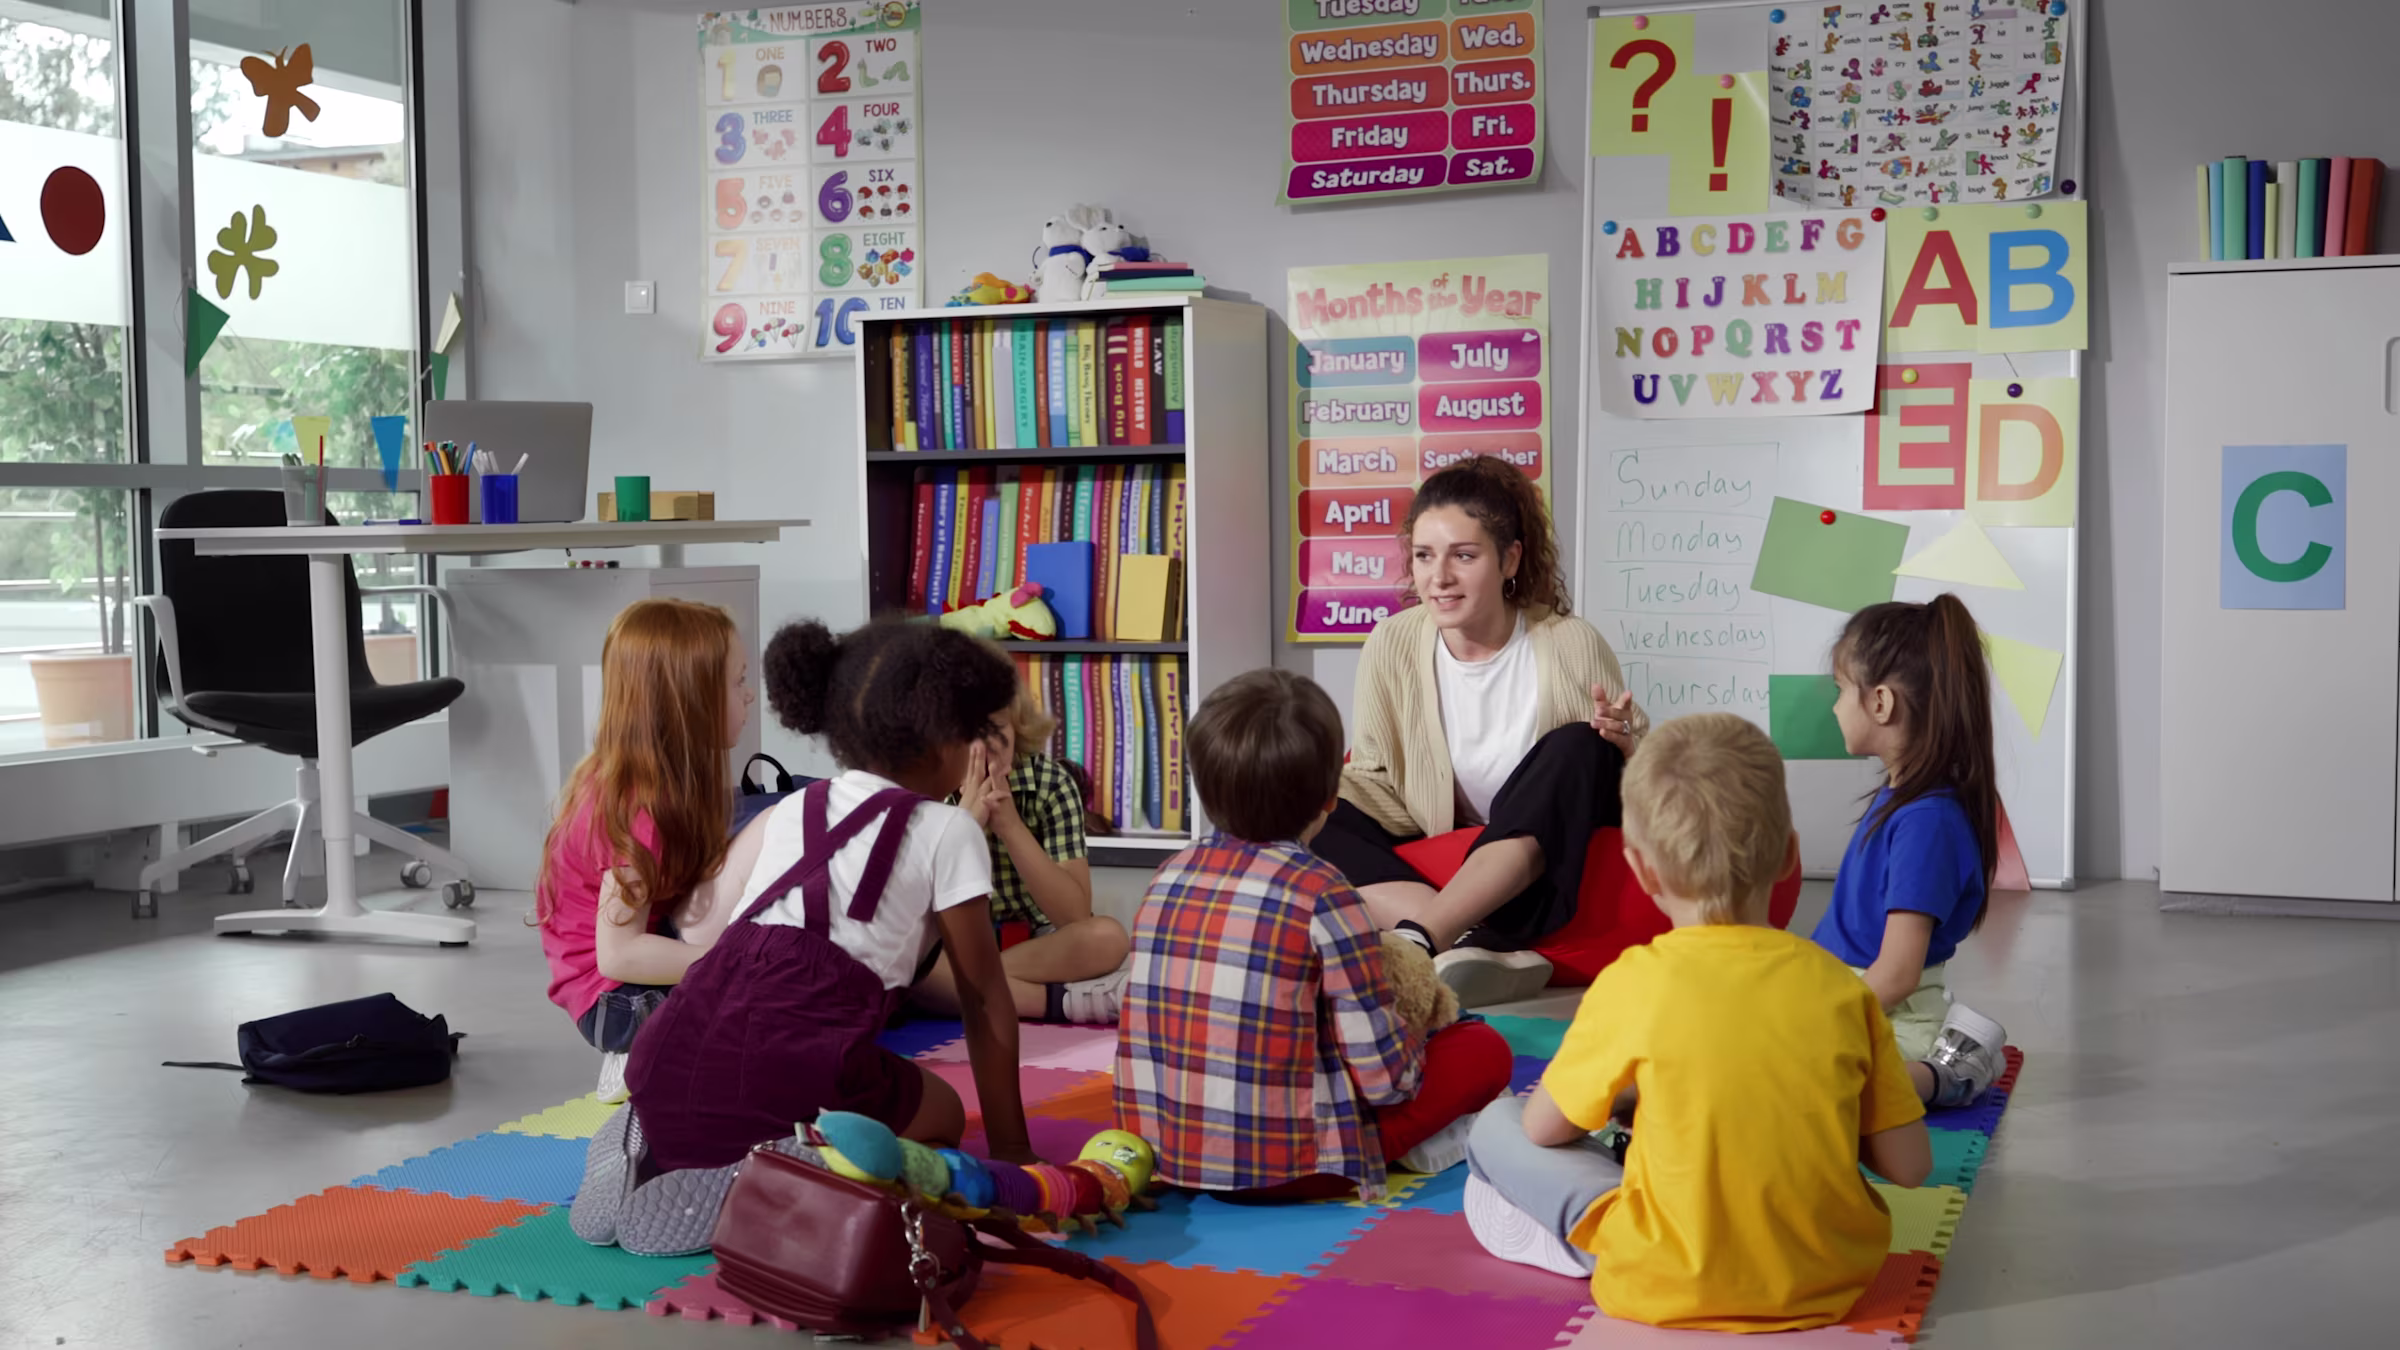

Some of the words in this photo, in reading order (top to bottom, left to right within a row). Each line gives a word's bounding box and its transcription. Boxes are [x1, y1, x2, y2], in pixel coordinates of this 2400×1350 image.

[769, 11, 848, 32] NUMBERS
[1460, 23, 1524, 49] Wed.
[756, 47, 784, 61] ONE
[866, 39, 896, 53] TWO
[1300, 34, 1438, 64] Wednesday
[718, 51, 736, 101] 1
[817, 40, 851, 93] 2
[1455, 71, 1531, 93] Thurs.
[1313, 79, 1426, 106] Thursday
[1610, 39, 1676, 132] ?
[1989, 81, 2010, 89] juggle
[752, 110, 792, 124] THREE
[864, 103, 900, 117] FOUR
[1472, 115, 1514, 137] Fri.
[715, 112, 746, 165] 3
[816, 105, 851, 158] 4
[1331, 125, 1408, 148] Friday
[1709, 98, 1732, 191] !
[760, 176, 792, 188] FIVE
[868, 169, 894, 183] SIX
[1311, 167, 1424, 188] Saturday
[1465, 156, 1515, 177] Sat.
[715, 177, 747, 230] 5
[819, 171, 853, 223] 6
[863, 232, 905, 246] EIGHT
[715, 239, 746, 291] 7
[819, 233, 853, 287] 8
[1888, 231, 1977, 328] A
[1989, 229, 2074, 329] B
[760, 301, 796, 315] NINE
[880, 297, 905, 310] TEN
[1297, 282, 1423, 329] Months
[1432, 273, 1449, 288] of
[1461, 275, 1541, 318] Year
[713, 302, 747, 353] 9
[1134, 327, 1144, 368] WORLD
[1154, 337, 1163, 376] LAW
[1309, 350, 1405, 375] January
[1451, 342, 1509, 372] July
[1018, 369, 1028, 427] SURGERY
[1134, 378, 1145, 430] HISTORY
[1303, 401, 1410, 425] February
[1436, 392, 1525, 420] August
[954, 387, 962, 444] POLITICS
[1878, 387, 1955, 486] E
[1977, 403, 2063, 501] D
[1317, 448, 1396, 474] March
[1617, 450, 1752, 508] Sunday
[938, 485, 948, 526] Theory
[1325, 499, 1390, 533] April
[938, 529, 946, 541] of
[1617, 520, 1742, 558] Monday
[2232, 471, 2333, 582] C
[931, 544, 946, 605] Relativity
[1332, 551, 1384, 580] May
[1619, 568, 1741, 612] Tuesday
[1322, 601, 1389, 625] June
[1620, 619, 1766, 651] Wednesday
[1167, 672, 1179, 811] PHYSICS
